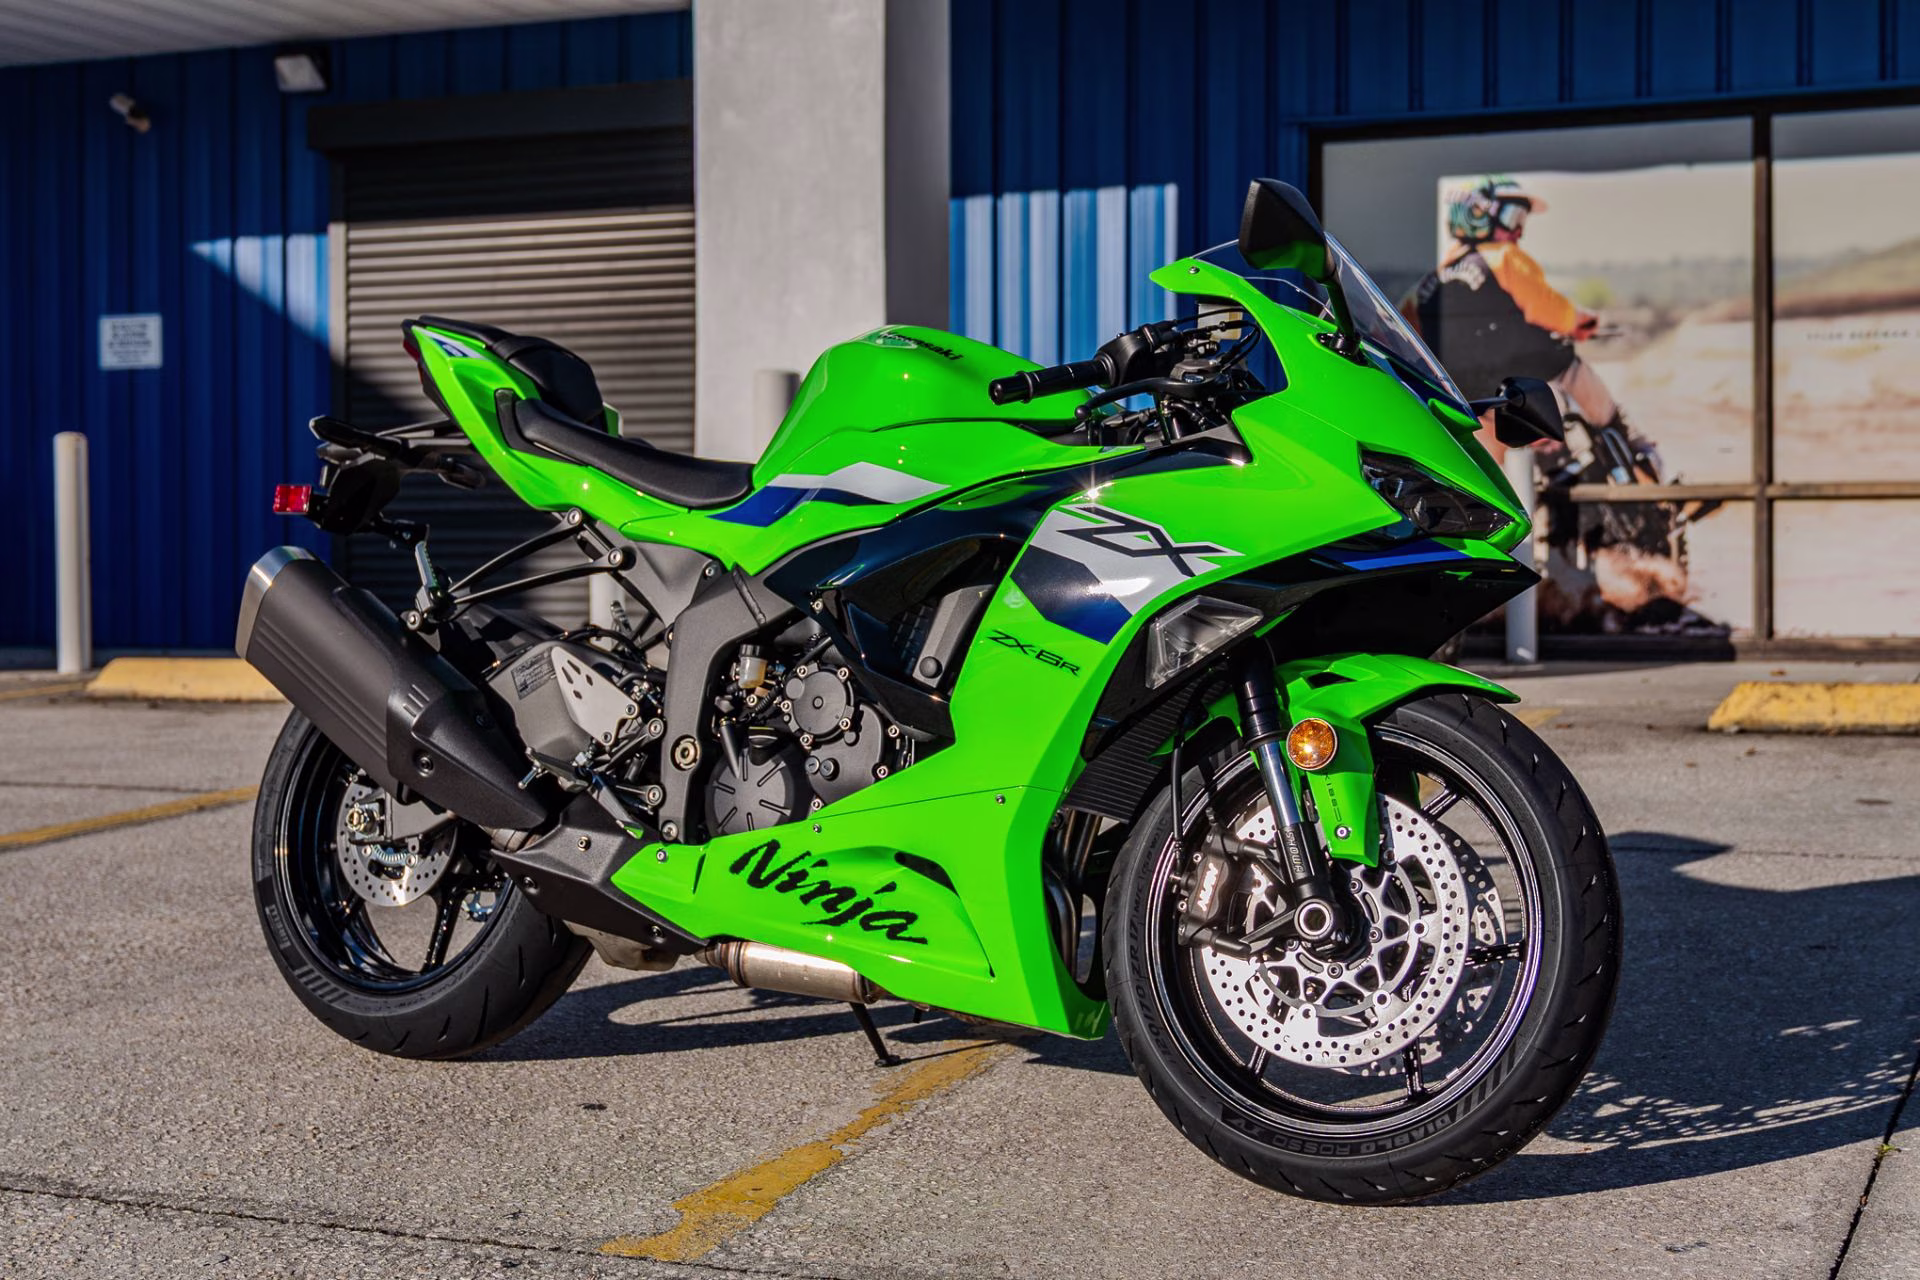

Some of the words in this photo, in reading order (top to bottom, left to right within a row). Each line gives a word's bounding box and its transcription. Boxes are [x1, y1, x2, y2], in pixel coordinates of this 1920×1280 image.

[987, 630, 1081, 676] ZX-6R
[1285, 830, 1305, 874] SHOWA
[729, 839, 928, 945] Ninja
[1272, 1134, 1350, 1155] ROSSO
[1361, 1114, 1451, 1154] DIABLO
